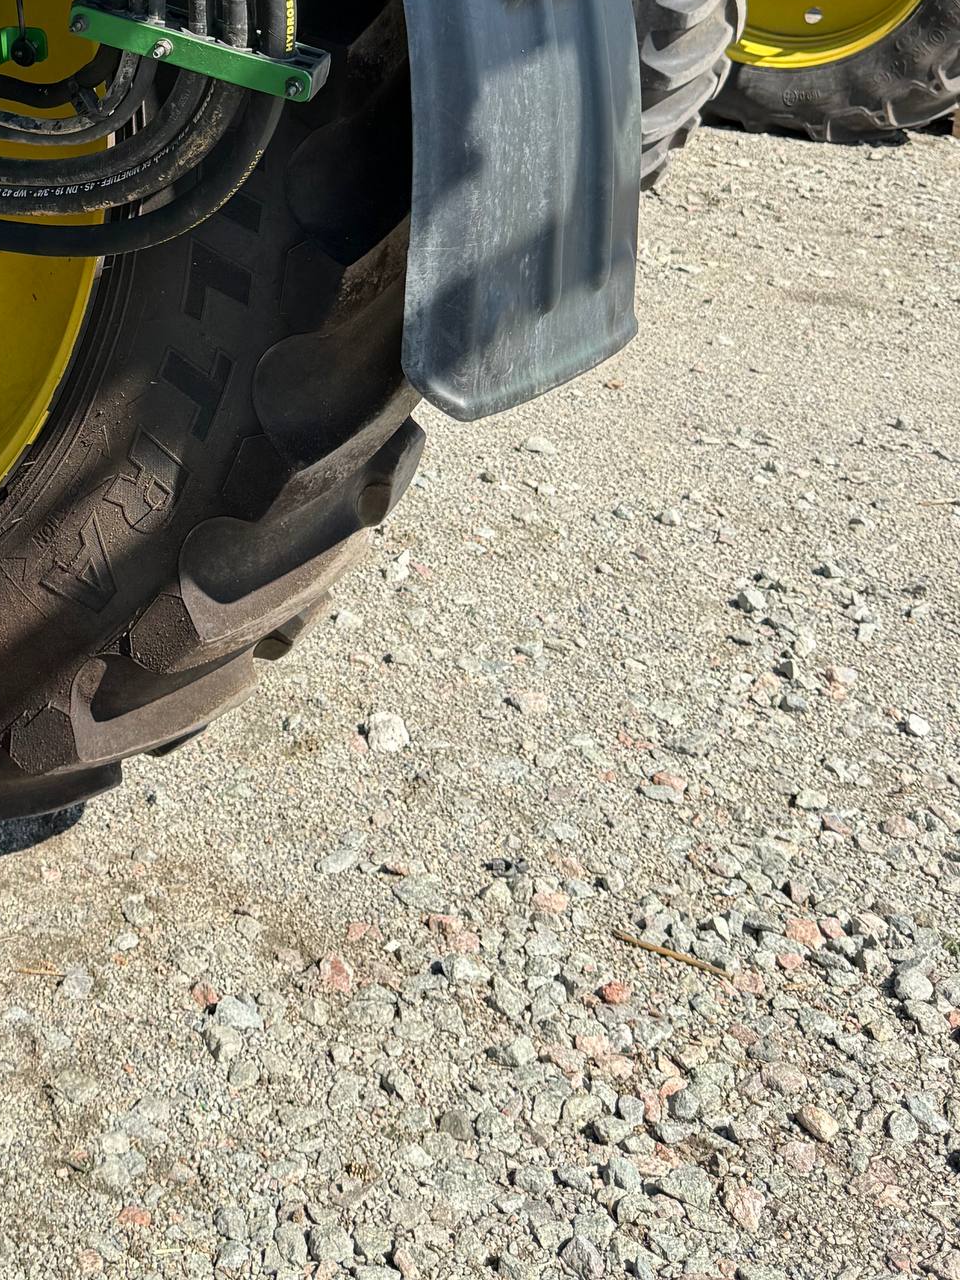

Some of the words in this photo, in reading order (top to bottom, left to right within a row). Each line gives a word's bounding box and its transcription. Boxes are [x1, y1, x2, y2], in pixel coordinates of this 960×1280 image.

[2, 188, 12, 196] 42
[13, 189, 26, 197] WP
[54, 187, 64, 195] 19
[64, 185, 79, 194] DN
